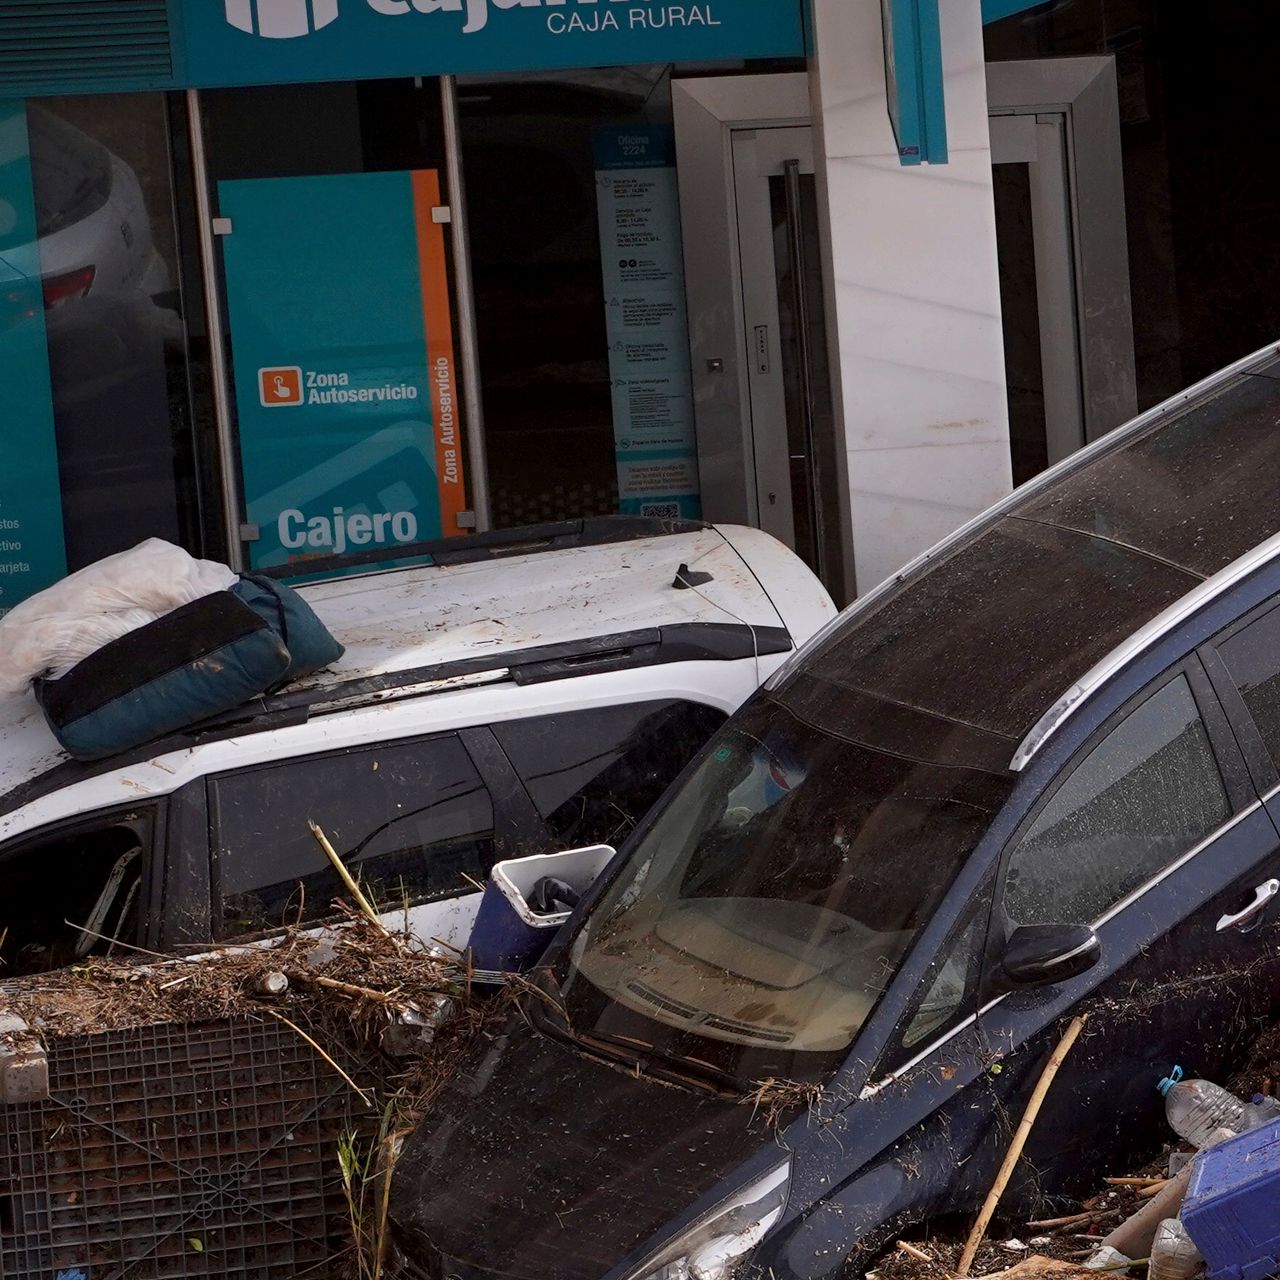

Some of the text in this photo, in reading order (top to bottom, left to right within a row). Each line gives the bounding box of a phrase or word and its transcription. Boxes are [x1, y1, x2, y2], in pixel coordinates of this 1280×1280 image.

[547, 11, 619, 34] CAJA
[629, 5, 721, 29] RURAL
[306, 371, 349, 388] Zona
[308, 383, 417, 405] Autoservicio
[434, 356, 459, 484] Zona Autoservicio
[278, 506, 418, 554] Cajero
